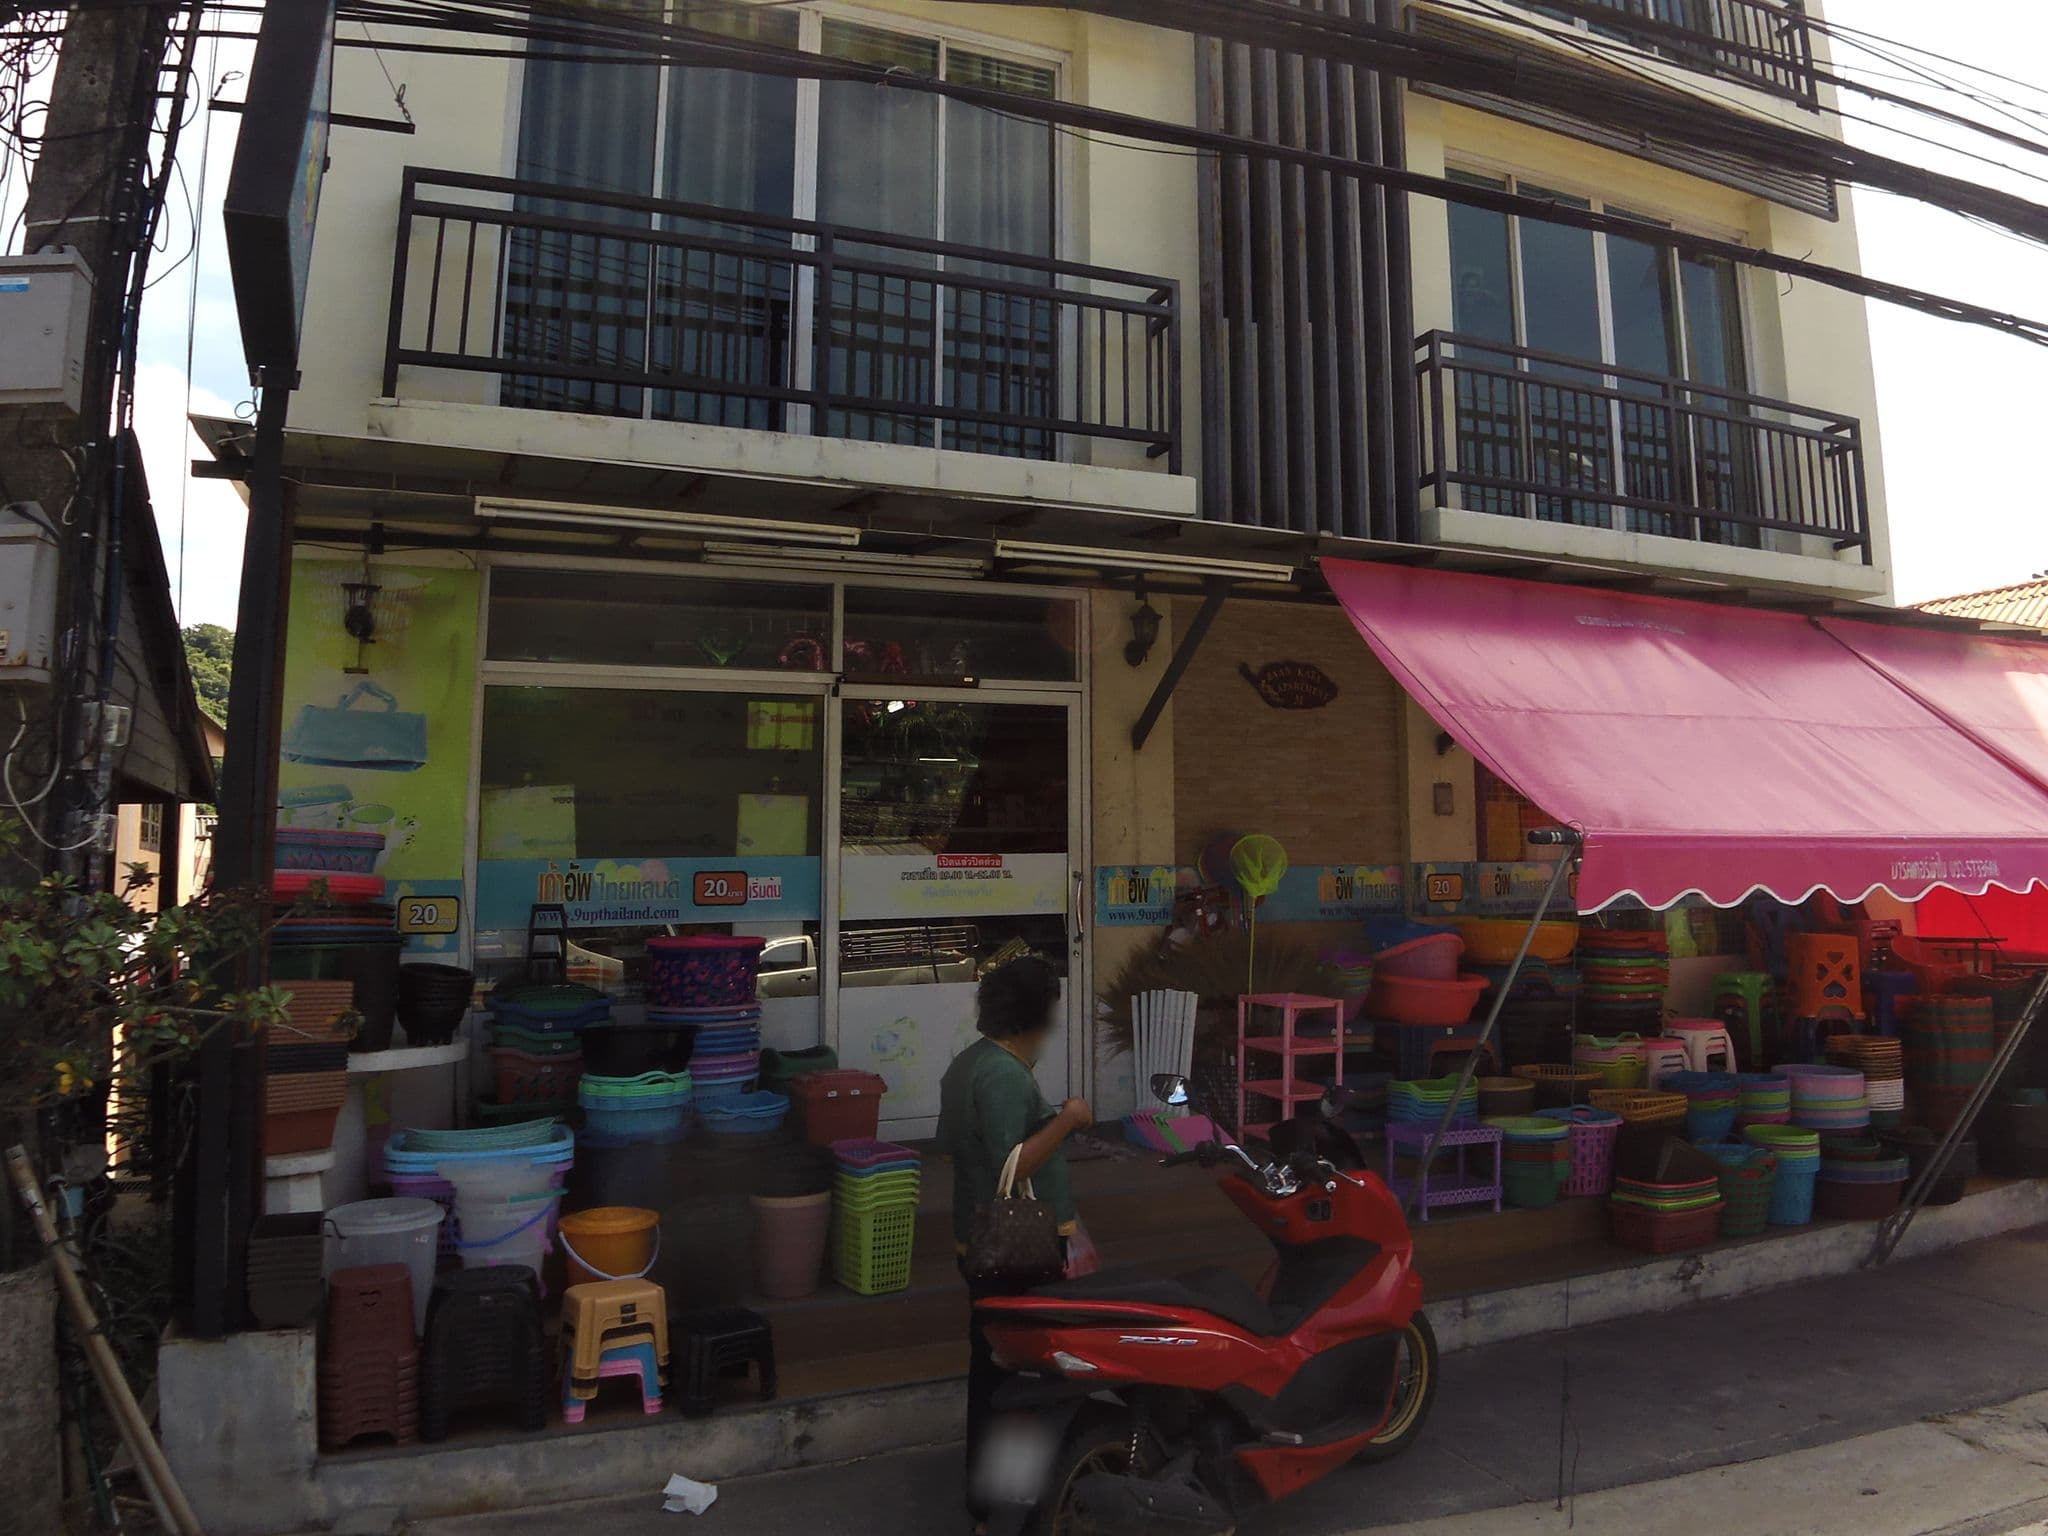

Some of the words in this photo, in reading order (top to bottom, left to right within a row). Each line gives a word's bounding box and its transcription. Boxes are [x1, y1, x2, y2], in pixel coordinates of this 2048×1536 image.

[704, 879, 728, 897] 20
[1434, 880, 1450, 894] 20
[410, 904, 438, 925] 20
